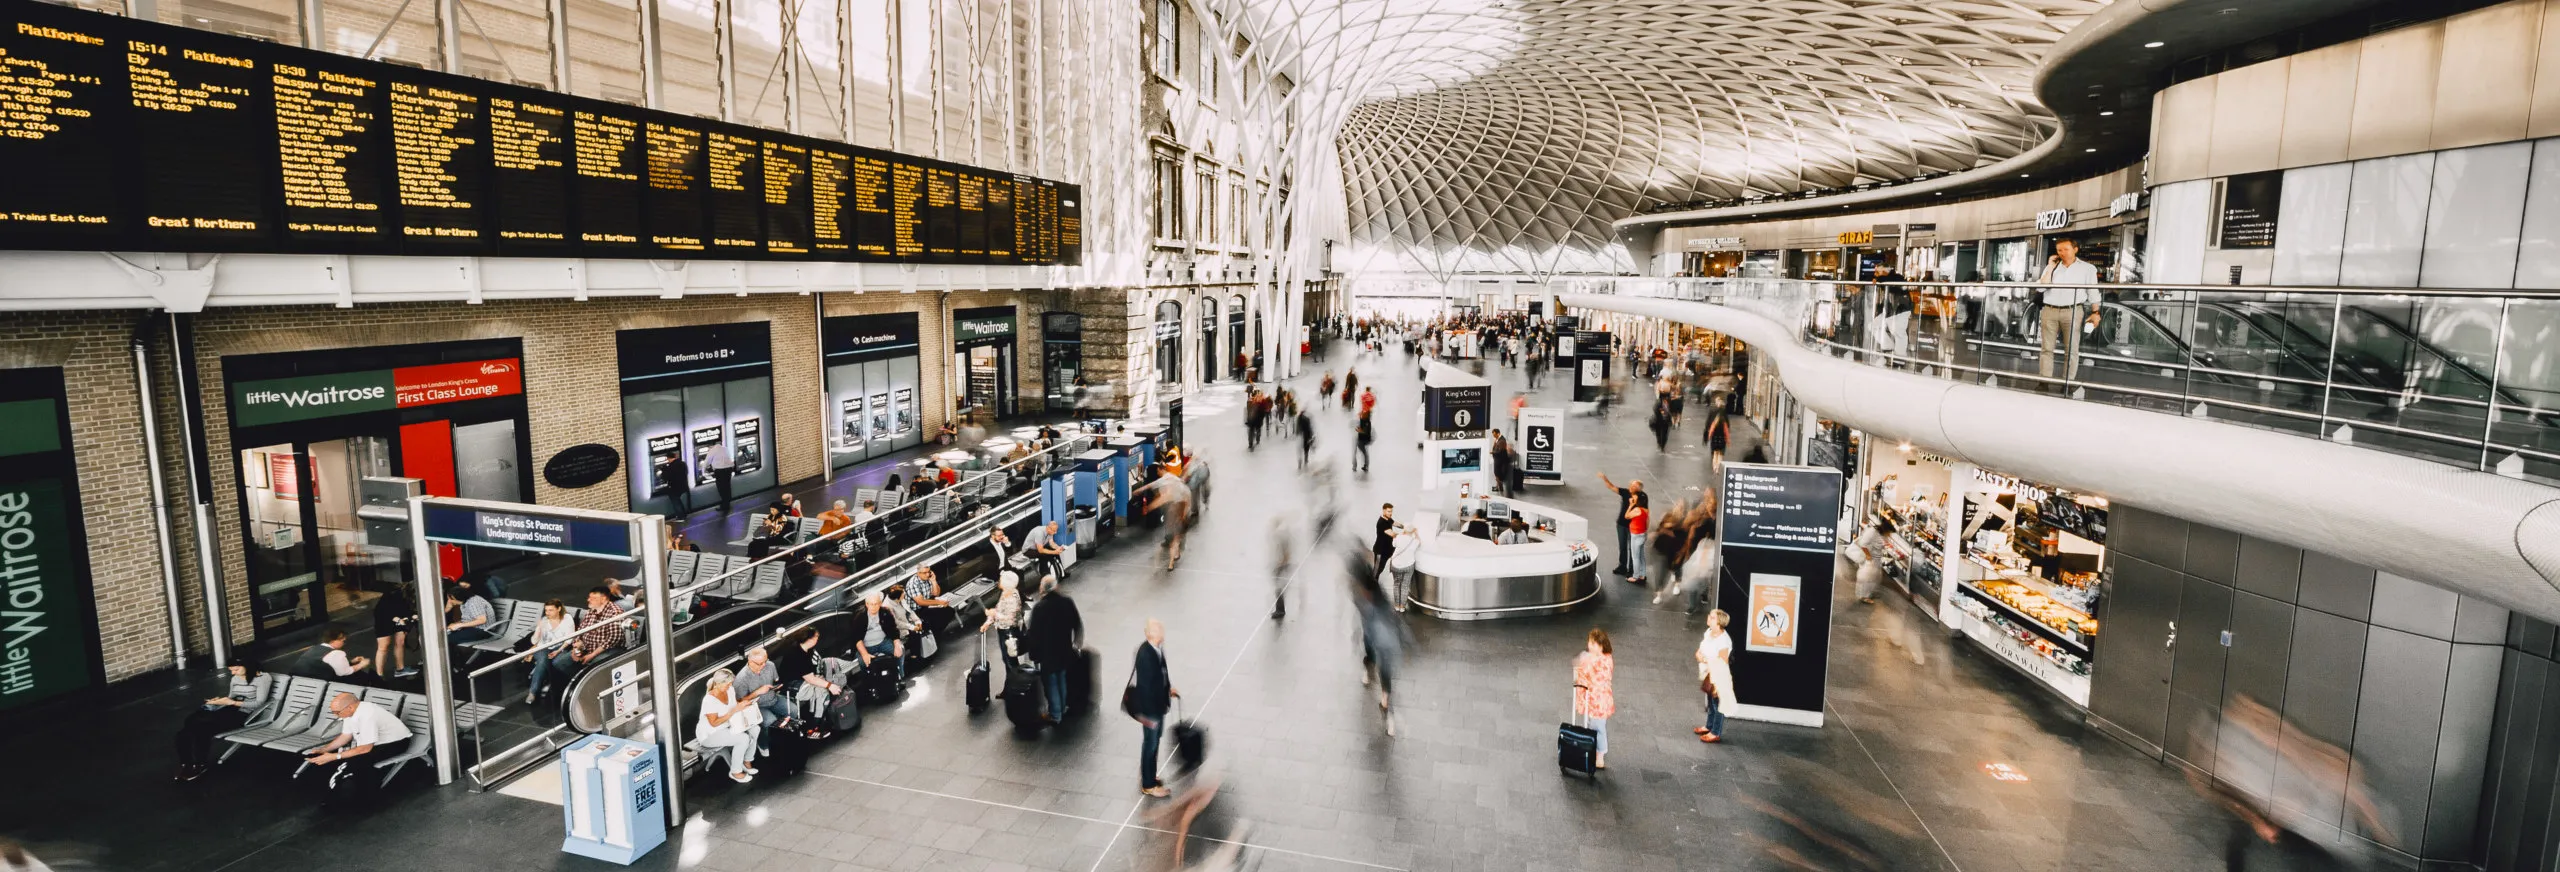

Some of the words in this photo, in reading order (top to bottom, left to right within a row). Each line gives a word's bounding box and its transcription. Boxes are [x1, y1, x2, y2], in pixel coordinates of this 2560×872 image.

[128, 40, 167, 56] 15:14
[4, 57, 47, 70] shortly
[128, 53, 149, 66] Ely
[129, 65, 169, 78] Boarding
[273, 64, 306, 77] 15:30
[41, 70, 67, 80] Page
[95, 77, 101, 85] 1
[130, 74, 161, 86] Calling
[131, 82, 177, 95] Cambridge
[201, 83, 222, 93] Page
[273, 75, 319, 90] Glasgow
[322, 82, 363, 97] Central
[274, 85, 311, 98] Preparing
[391, 82, 418, 94] 15:34
[132, 91, 178, 103] Cambridge
[180, 96, 207, 106] North
[144, 100, 159, 110] Ely
[275, 94, 308, 105] Boarding
[310, 99, 336, 108] approx
[391, 92, 457, 110] Peterborough
[491, 98, 514, 109] 15:35
[27, 104, 53, 114] Gate
[276, 101, 301, 111] Calling
[276, 109, 328, 122] Peterborough
[333, 109, 351, 117] Page
[491, 108, 516, 118] Leeds
[575, 111, 594, 121] 15:42
[278, 124, 316, 134] Doncaster
[284, 177, 320, 186] Edinburgh
[12, 213, 47, 222] Trains
[50, 214, 74, 223] East
[78, 215, 107, 223] Coast
[149, 217, 189, 228] Great
[195, 218, 255, 231] Northern
[2036, 208, 2069, 230] PREZZO
[288, 223, 311, 232] Virgin
[313, 224, 335, 232] Trains
[404, 227, 432, 236] Great
[435, 228, 478, 237] Northern
[582, 233, 603, 242] Great
[605, 234, 636, 243] Northern
[962, 321, 974, 330] little
[975, 322, 1009, 335] Waitrose
[861, 336, 874, 344] Cash
[874, 333, 896, 342] machines
[666, 352, 699, 363] Platforms
[700, 352, 704, 360] 0
[706, 351, 713, 359] to
[714, 350, 719, 358] 8
[247, 391, 280, 405] little
[281, 385, 385, 408] Waitrose
[397, 393, 424, 404] First
[427, 389, 456, 400] Class
[459, 385, 498, 396] Lounge
[1973, 468, 2011, 489] PASTY
[2011, 479, 2048, 503] SHOP
[1765, 502, 1784, 510] seating
[483, 516, 503, 527] King's
[505, 518, 525, 528] Cross
[526, 520, 534, 529] St
[535, 520, 564, 531] Pancras
[487, 528, 533, 541] Underground
[534, 532, 561, 543] Station
[0, 491, 48, 648] Waitrose
[1995, 643, 2046, 679] CORNWALL
[0, 647, 34, 694] little
[634, 767, 654, 783] METRO
[636, 784, 656, 804] FREE
